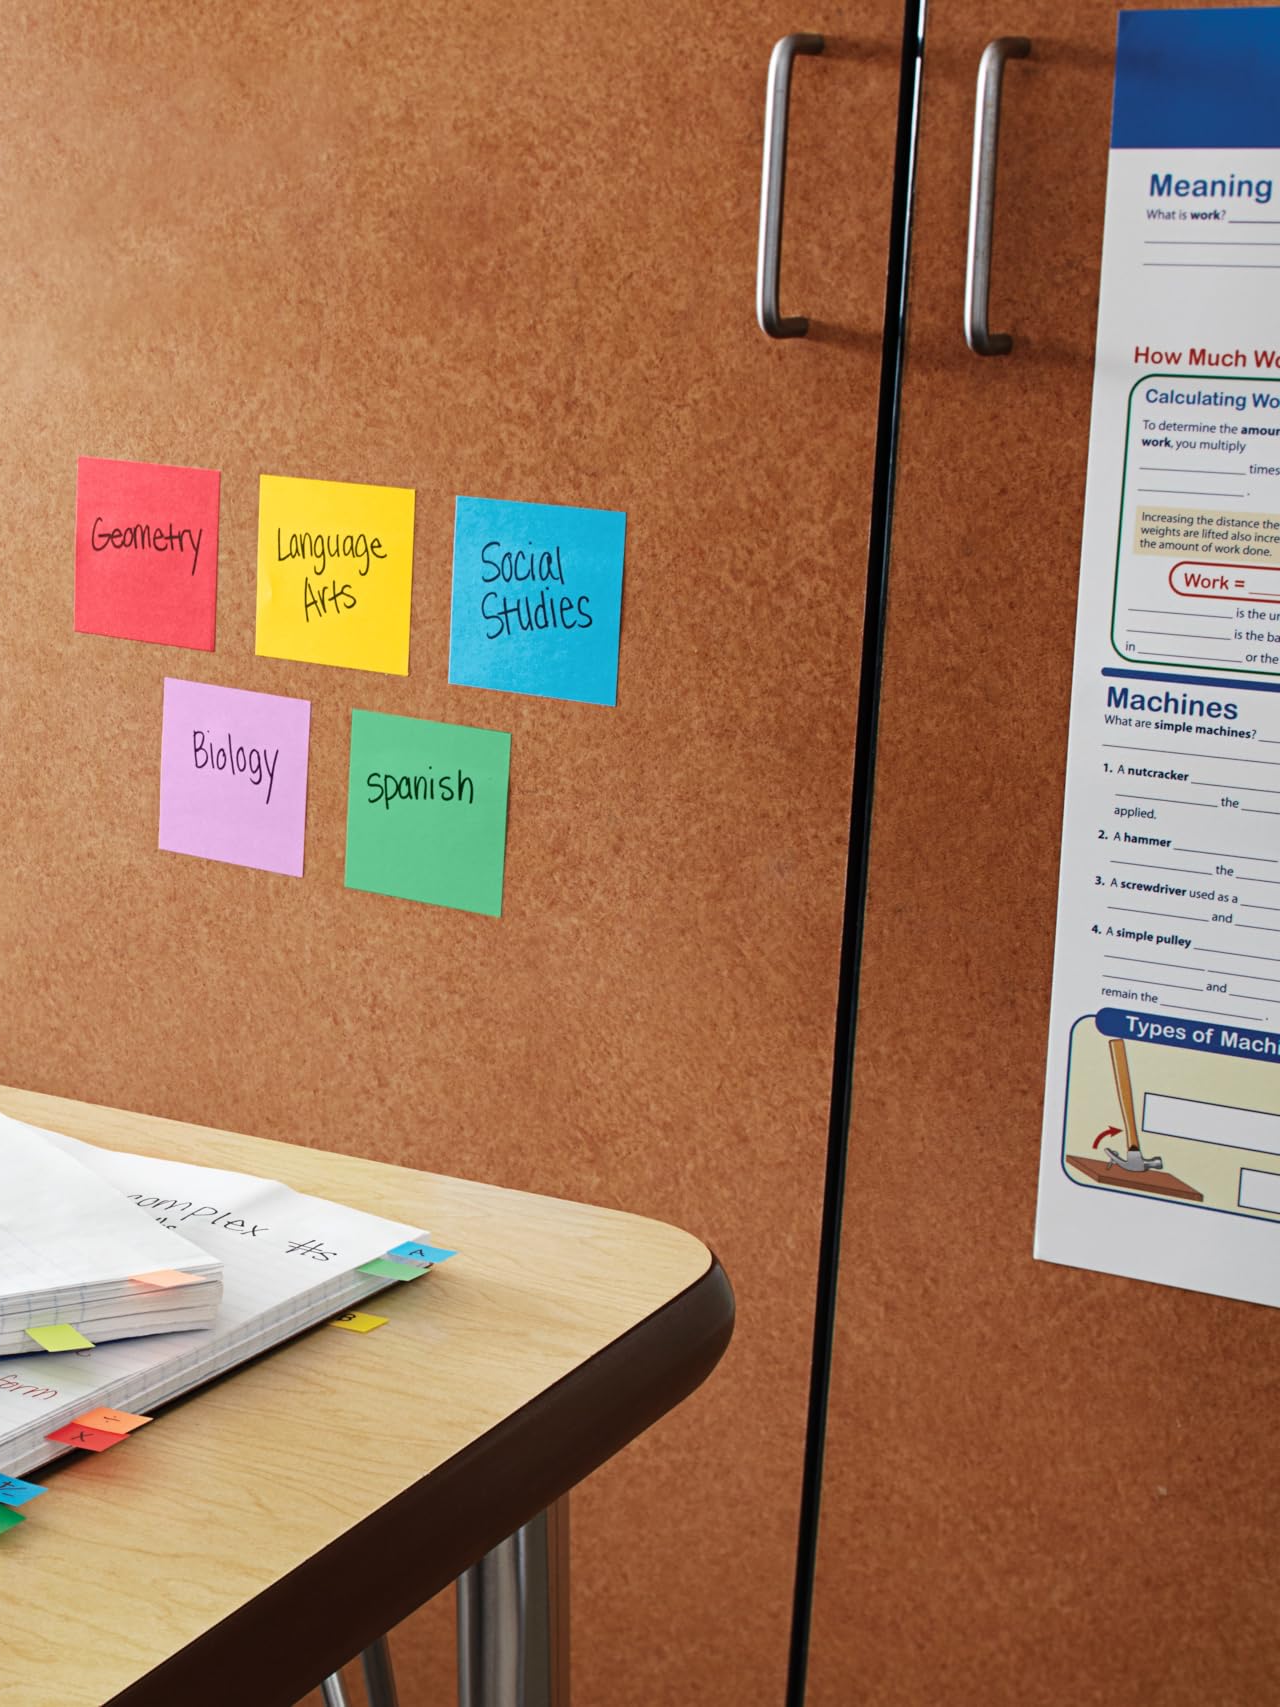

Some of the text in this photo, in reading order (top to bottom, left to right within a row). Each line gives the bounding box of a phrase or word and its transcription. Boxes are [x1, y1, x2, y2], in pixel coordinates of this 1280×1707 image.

[1150, 174, 1273, 203] Meaning
[1146, 209, 1226, 220] What is work?
[1134, 347, 1182, 365] How
[1188, 349, 1247, 367] Much
[1145, 388, 1246, 411] Calculating
[1143, 419, 1156, 430] To
[1158, 421, 1217, 433] determine
[1219, 423, 1239, 434] the
[1141, 437, 1246, 454] work, you multiply
[1249, 464, 1280, 476] times
[1142, 512, 1280, 530] Increasing the distance the
[1140, 526, 1181, 539] weights
[1183, 530, 1199, 538] are
[1202, 529, 1228, 540] lifted
[1231, 532, 1252, 541] also
[91, 516, 203, 577] Geometry
[277, 527, 387, 576] Language
[1140, 539, 1272, 557] the amount of work done.
[481, 541, 565, 585] Social
[1184, 572, 1229, 590] Work
[304, 577, 357, 622] Arts
[481, 586, 593, 639] Studies
[1236, 608, 1245, 618] is
[1247, 609, 1266, 620] the
[1234, 629, 1243, 640] is
[1245, 631, 1264, 641] the
[1125, 642, 1135, 651] in
[1245, 653, 1279, 664] or the
[1106, 686, 1238, 720] Machines
[1104, 714, 1257, 739] What are simple machines?
[193, 728, 279, 805] Biology
[1103, 763, 1189, 781] 1. A nutcracker
[1221, 797, 1239, 808] the
[1114, 806, 1157, 820] applied.
[1098, 829, 1172, 847] 2. A hammer
[1215, 866, 1234, 877] the
[1094, 876, 1238, 904] 3. A screwdriver used as a
[1211, 912, 1233, 924] and
[1091, 925, 1192, 949] 4. A simple pulley
[1101, 987, 1158, 1003] remain the
[1206, 983, 1227, 994] and
[1126, 1015, 1186, 1040] Types
[1192, 1028, 1214, 1045] of
